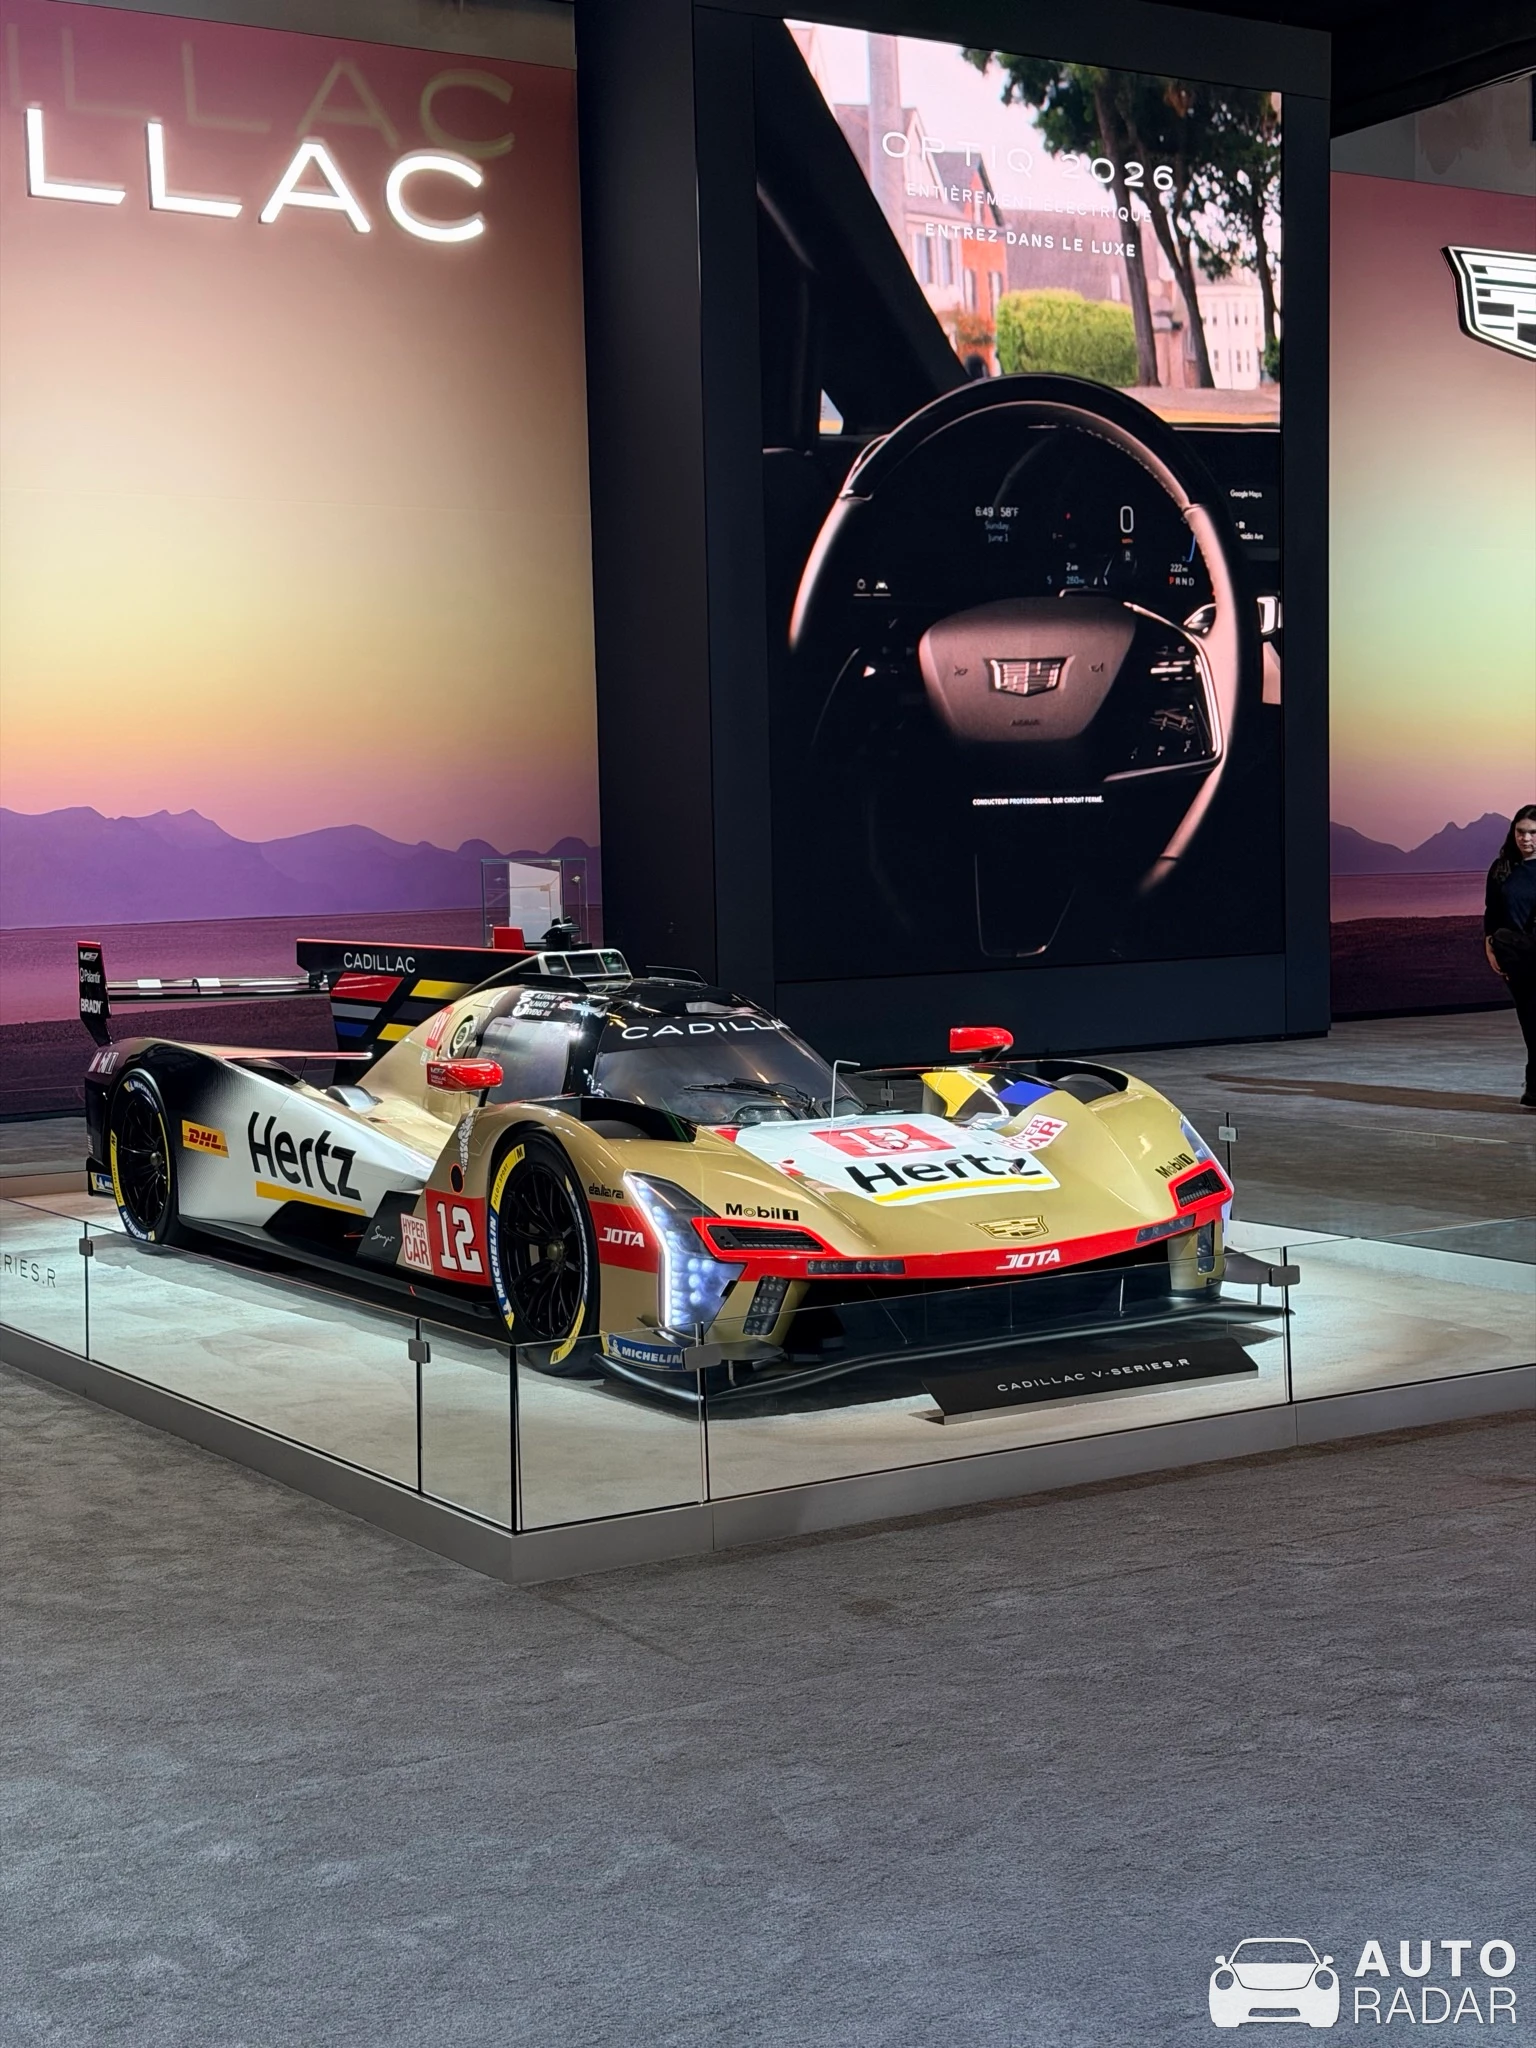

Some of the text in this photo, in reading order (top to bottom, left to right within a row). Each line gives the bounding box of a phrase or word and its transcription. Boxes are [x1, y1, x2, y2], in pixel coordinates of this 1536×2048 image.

[25, 106, 486, 243] LLAC
[881, 131, 1174, 191] OPTIQ 2026
[905, 182, 1034, 210] ENTIÈREMENT
[925, 222, 1136, 258] ENTREZ DANS LE LUXE
[1120, 505, 1134, 533] 0
[343, 952, 416, 973] CADILLAC
[80, 997, 102, 1015] BRADY
[188, 1127, 222, 1151] DHL
[1009, 1121, 1063, 1150] CAR
[247, 1111, 362, 1201] Hertz
[843, 1153, 1043, 1194] Hertz
[402, 1217, 426, 1239] HYPER
[436, 1200, 484, 1274] 12
[599, 1227, 645, 1248] JOTA
[403, 1235, 430, 1266] CAR
[489, 1215, 508, 1300] MICHELIN
[995, 1248, 1062, 1270] JOTA
[0, 1253, 56, 1288] RIES.R
[621, 1346, 681, 1364] MICHELIN
[997, 1357, 1191, 1393] CADILLAC V-SERIES.R
